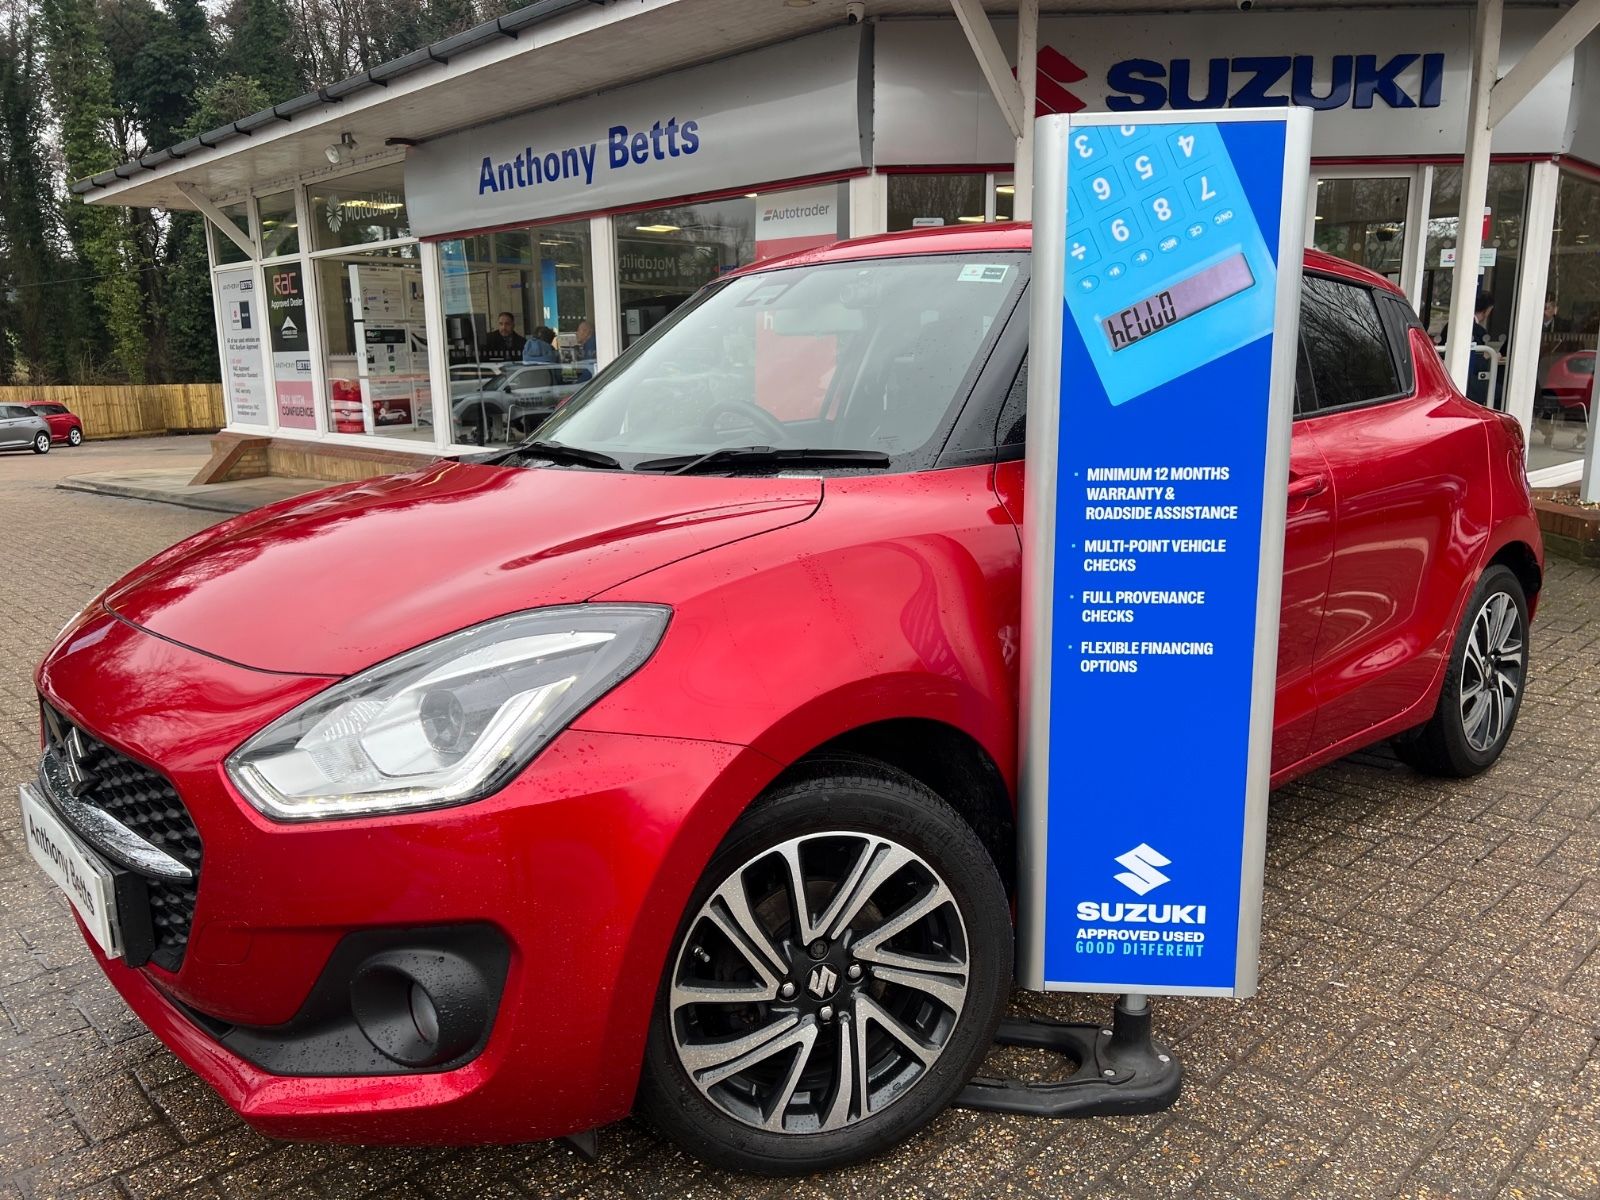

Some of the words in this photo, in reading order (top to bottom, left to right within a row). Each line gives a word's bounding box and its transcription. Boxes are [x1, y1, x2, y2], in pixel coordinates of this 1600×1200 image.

[1106, 53, 1445, 110] SUZUKI
[479, 144, 596, 195] Anthony
[608, 117, 699, 169] Betts
[772, 204, 830, 221] Autotrader
[281, 406, 314, 418] CONFIDENCE
[1087, 467, 1152, 481] MINIMUM
[1154, 467, 1168, 481] 12
[1171, 466, 1230, 481] MONTHS
[1087, 487, 1164, 500] WARRANTY
[1165, 487, 1175, 500] &
[1086, 507, 1152, 520] ROADSIDE
[1154, 506, 1238, 520] ASSISTANCE
[1084, 539, 1170, 553] MULTI-POINT
[1172, 539, 1226, 553] VEHICLE
[1084, 559, 1136, 572] CHECKS
[1082, 591, 1113, 604] FULL
[1116, 591, 1205, 604] PROVENANCE
[1082, 610, 1134, 622] CHECKS
[1081, 641, 1139, 654] FLEXIBLE
[1141, 642, 1214, 655] FINANCING
[1080, 660, 1138, 673] OPTIONS
[29, 814, 69, 884] Anthony
[69, 857, 95, 916] Betts
[1076, 901, 1207, 924] SUZUKI
[1076, 928, 1160, 942] APPROVED
[1162, 931, 1205, 943] USED
[1075, 941, 1115, 955] GOOD
[1123, 942, 1204, 957] DIFFERENT
